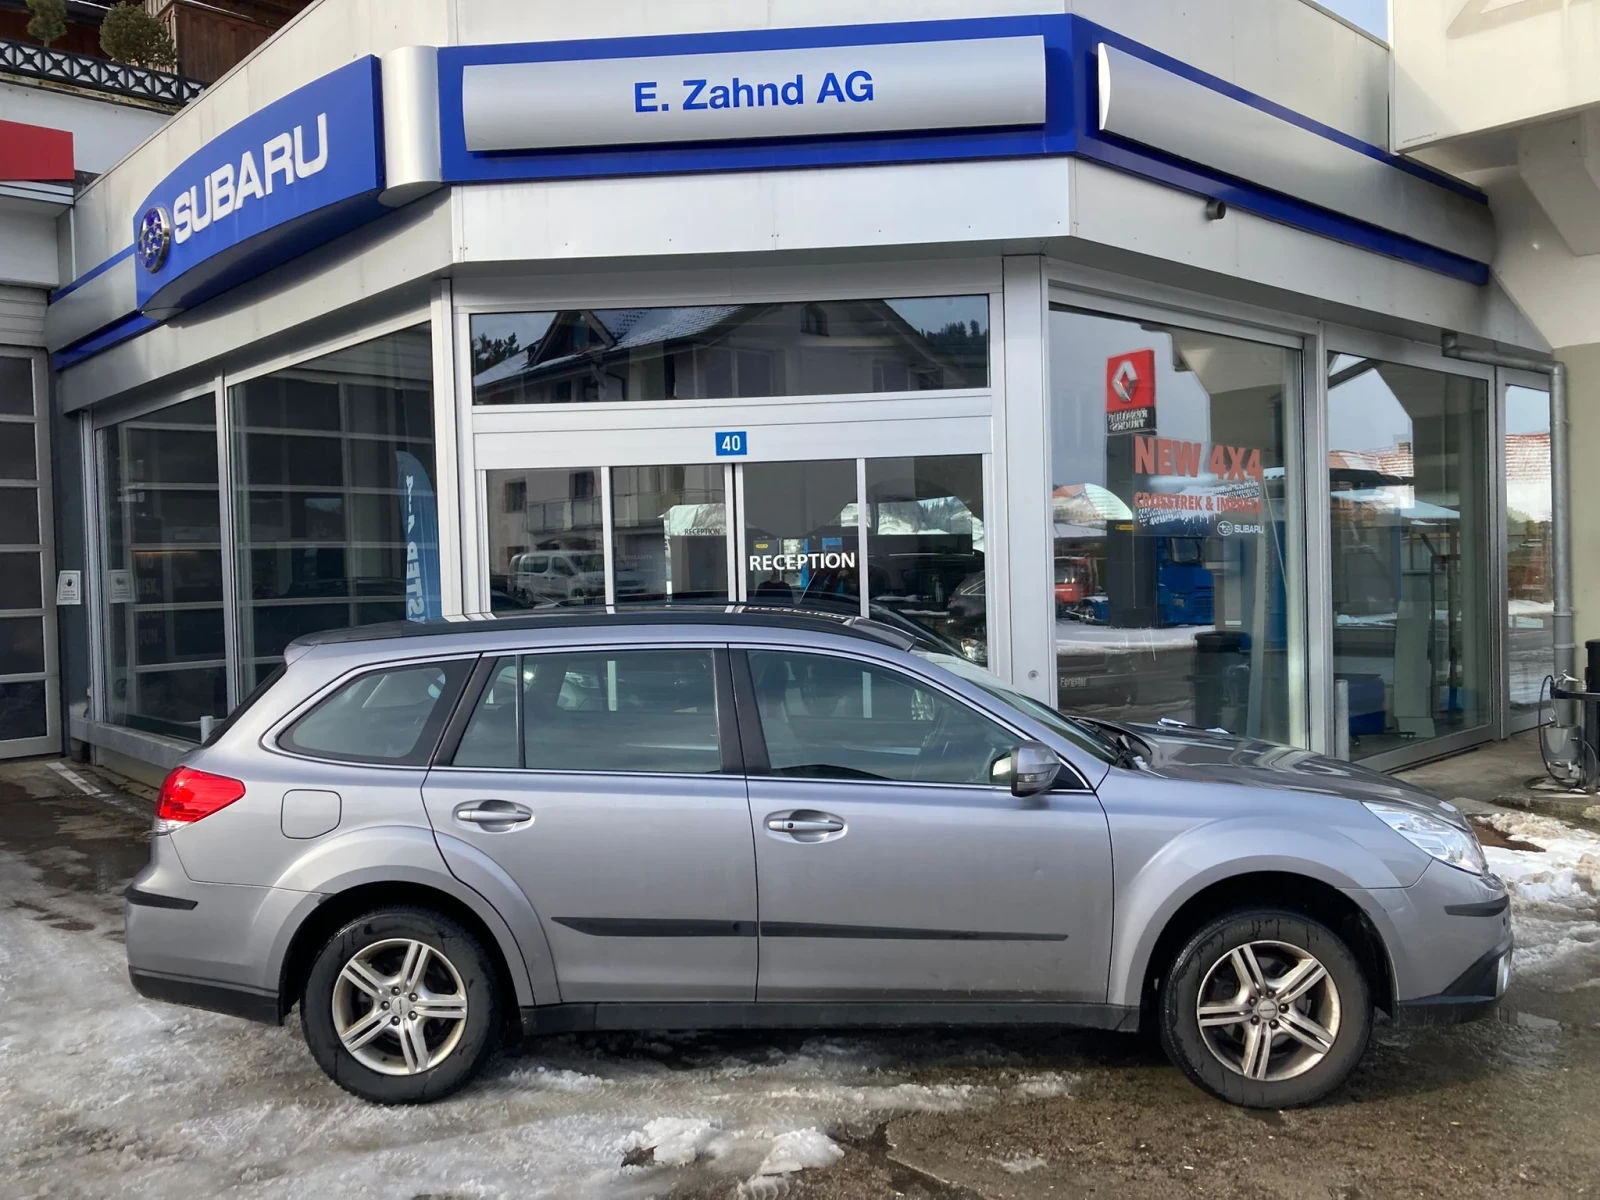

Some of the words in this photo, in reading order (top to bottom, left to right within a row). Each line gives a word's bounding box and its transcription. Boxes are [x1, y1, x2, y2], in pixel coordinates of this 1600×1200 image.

[634, 82, 669, 112] E.
[682, 74, 804, 110] Zahnd
[816, 70, 874, 103] AG
[173, 112, 328, 244] SUBARU
[721, 435, 741, 451] 40
[1134, 436, 1202, 478] NEW
[1210, 445, 1263, 482] 4X4
[1133, 492, 1203, 511] CROSSTREK
[1205, 495, 1214, 511] &
[684, 528, 720, 536] RECEPTION
[1234, 525, 1264, 534] SUBARU
[749, 552, 855, 571] RECEPTION
